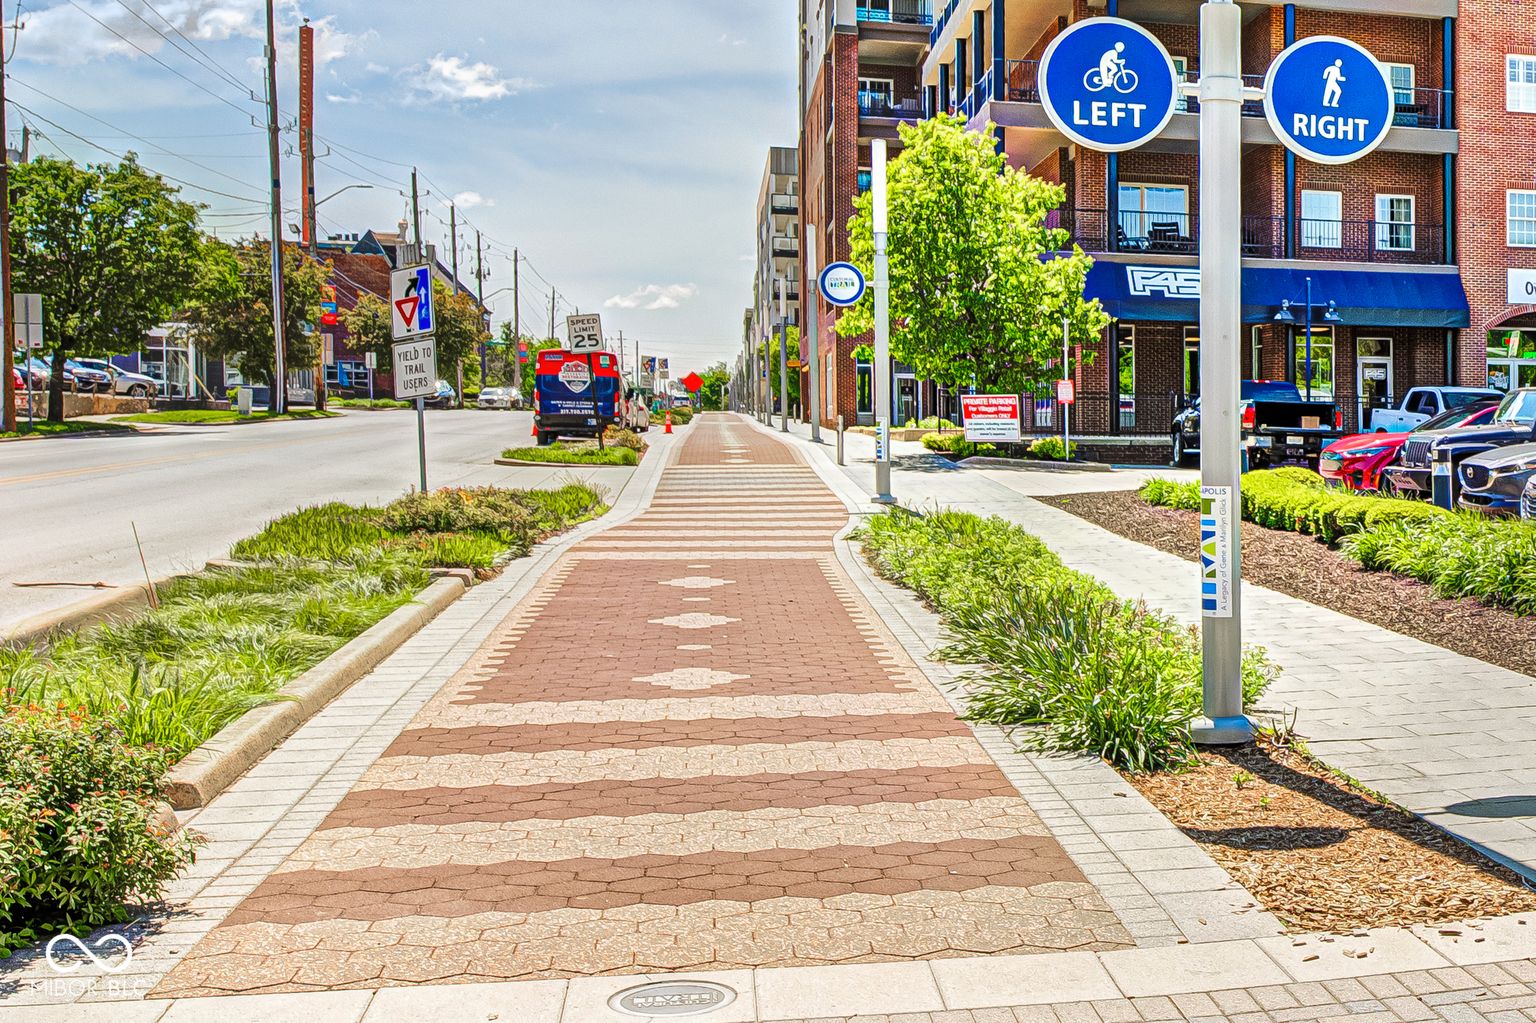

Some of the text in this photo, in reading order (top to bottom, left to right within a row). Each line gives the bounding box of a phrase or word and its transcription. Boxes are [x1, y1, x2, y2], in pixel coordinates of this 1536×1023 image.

[1073, 100, 1146, 128] LEFT
[1293, 113, 1369, 141] RIGHT
[1127, 267, 1200, 297] F45
[570, 318, 598, 326] SPEED
[573, 326, 596, 334] LIMIT
[573, 334, 600, 349] 25
[397, 347, 432, 363] YIELD TO
[404, 363, 426, 375] TRAIL
[403, 377, 428, 391] USERS
[1219, 498, 1227, 516] Glick
[1219, 517, 1228, 543] Marilyn
[1219, 550, 1227, 569] Gene
[1220, 570, 1227, 578] of
[1221, 579, 1229, 604] Legacy
